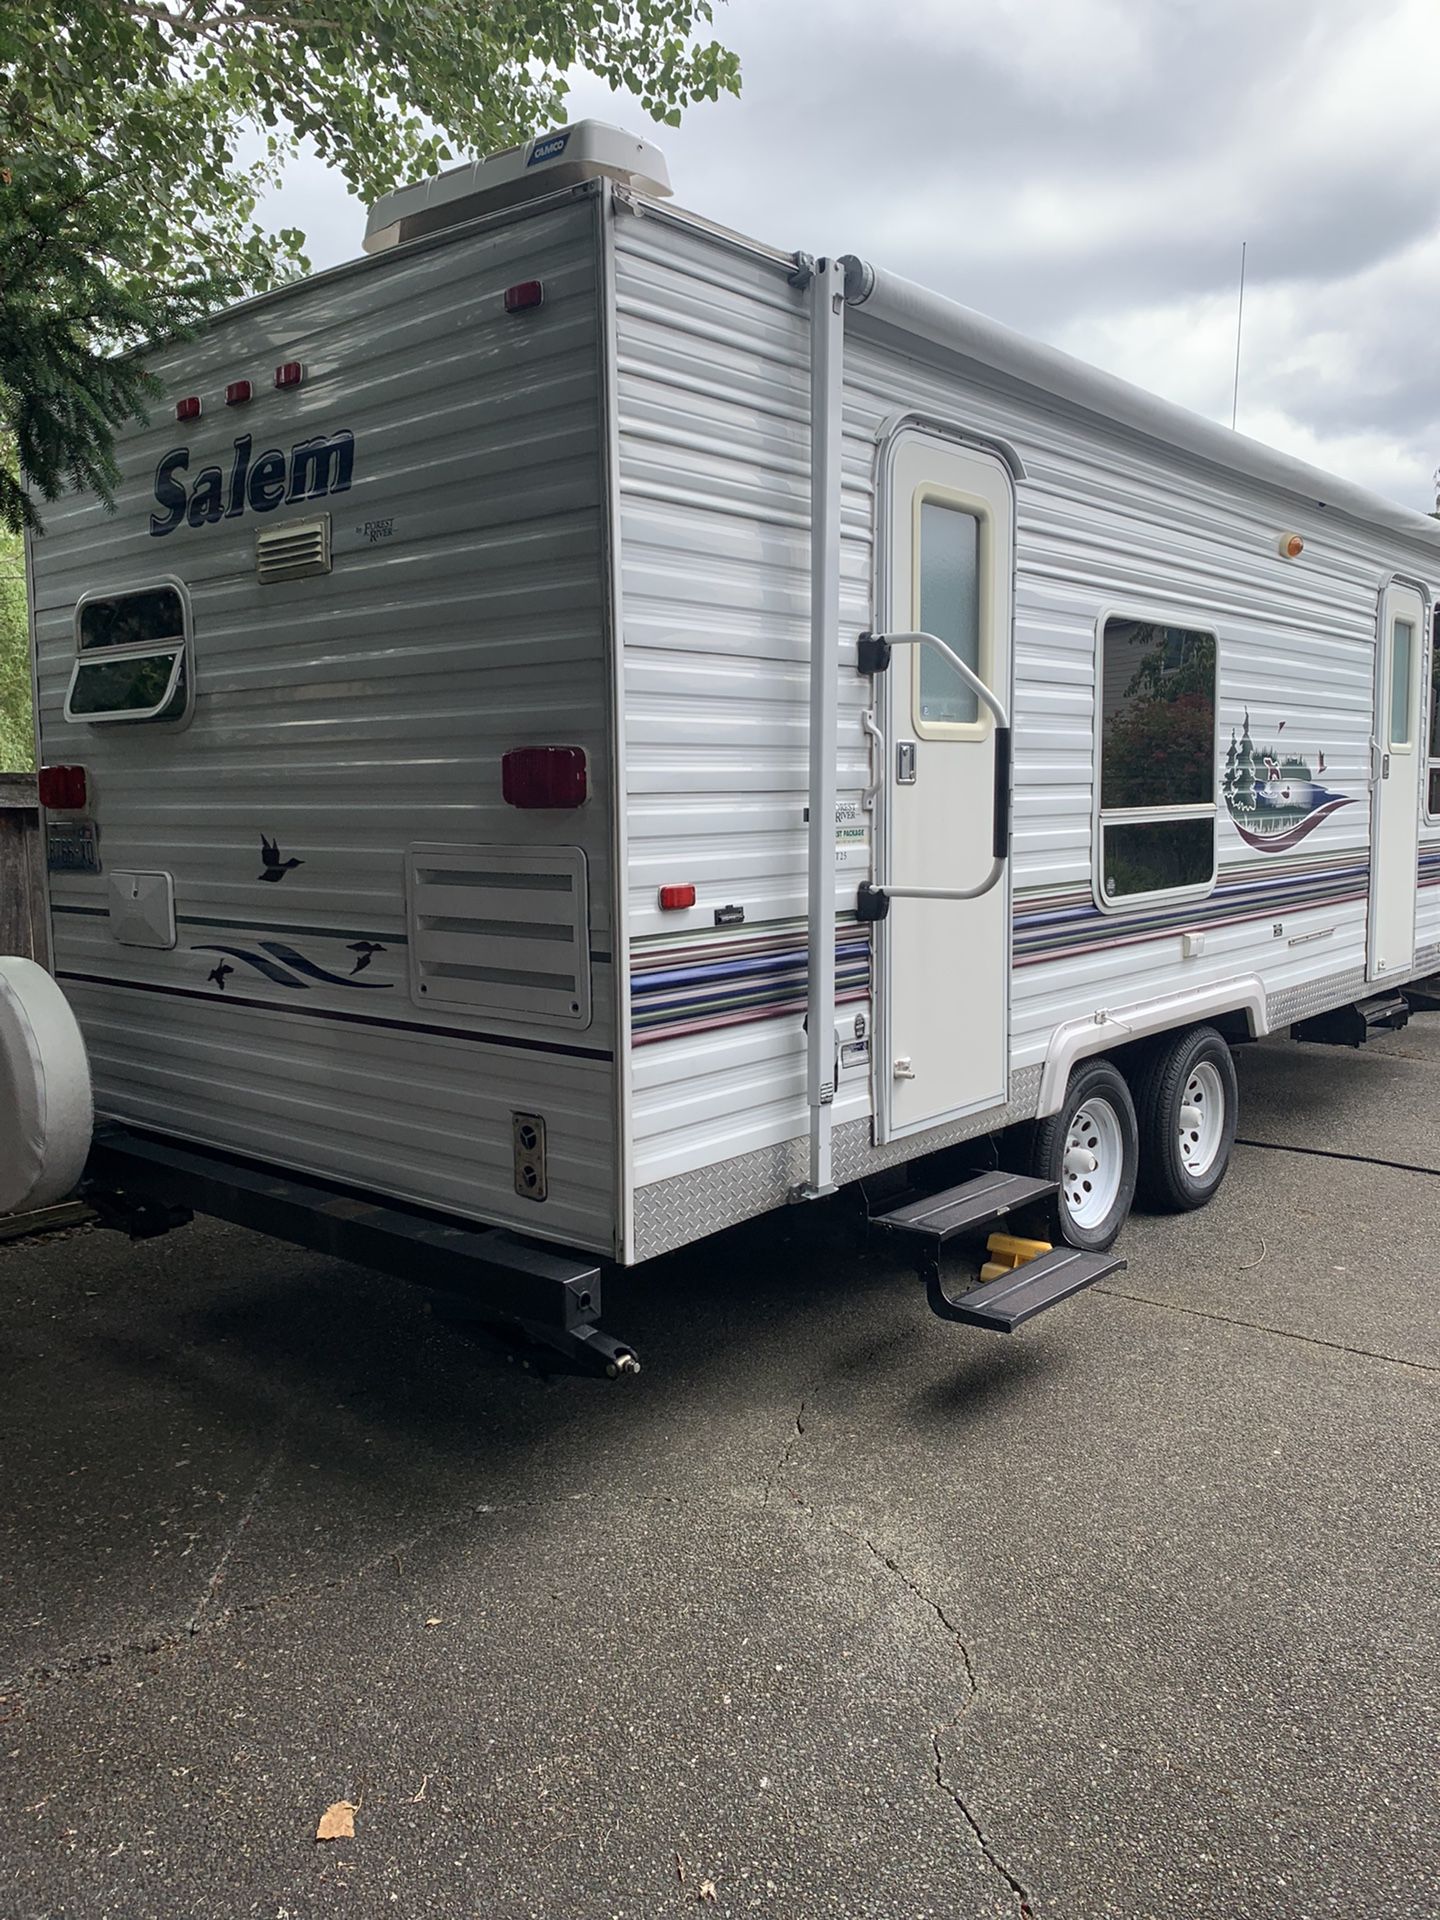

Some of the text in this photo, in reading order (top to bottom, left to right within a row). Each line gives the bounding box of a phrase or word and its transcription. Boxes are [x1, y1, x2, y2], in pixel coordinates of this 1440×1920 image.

[534, 140, 565, 158] CAMCO
[149, 428, 355, 537] Salem
[370, 528, 393, 543] RIVER
